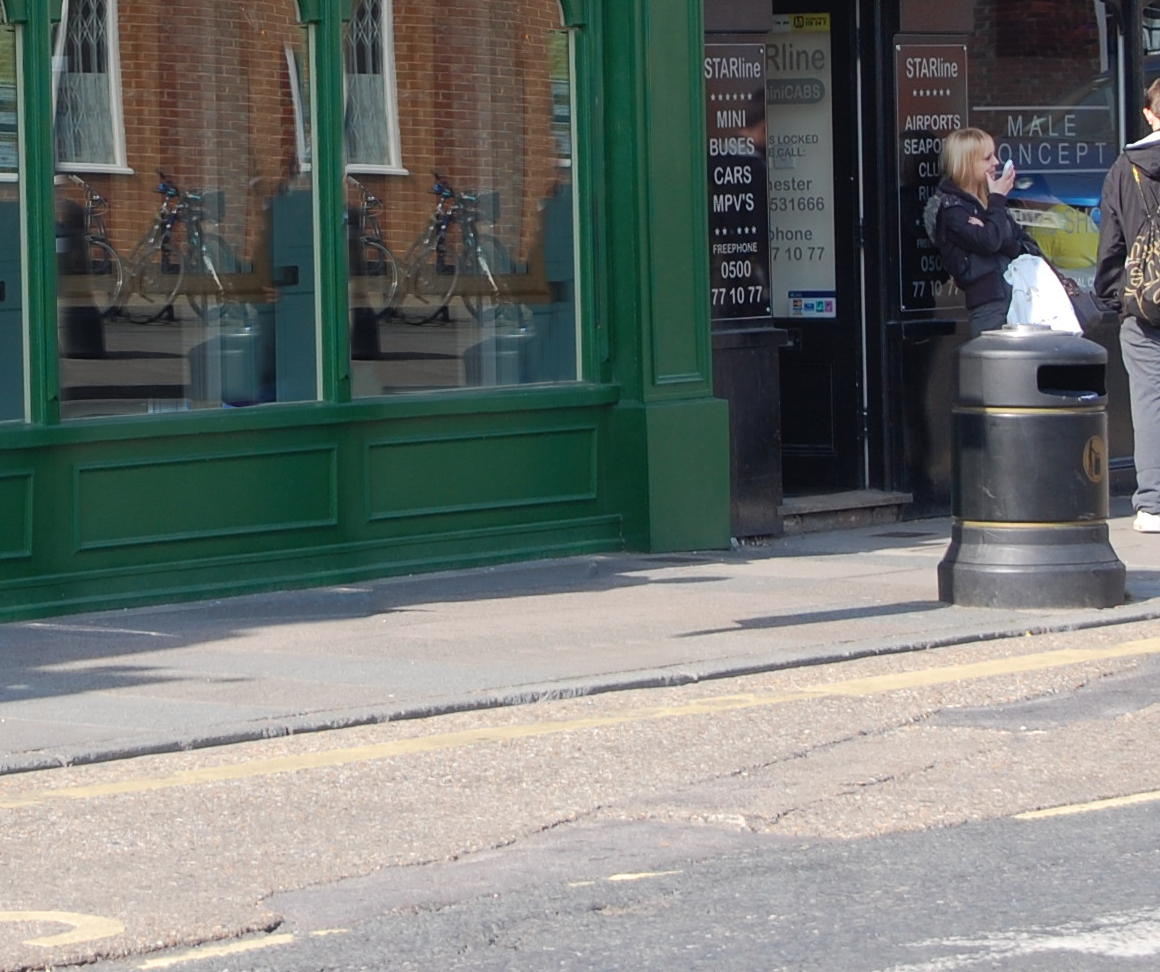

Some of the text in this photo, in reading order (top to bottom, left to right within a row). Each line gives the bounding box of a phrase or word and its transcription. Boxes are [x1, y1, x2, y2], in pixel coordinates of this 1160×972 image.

[765, 43, 826, 72] Rline
[704, 57, 761, 79] STARline
[906, 57, 959, 79] STARline
[716, 110, 746, 129] MINI
[904, 114, 961, 130] AIRPORTS
[1007, 114, 1076, 137] MALE
[709, 137, 755, 156] BUSES
[777, 134, 819, 145] LOCKED
[997, 142, 1107, 165] ONCEPT
[713, 166, 752, 185] CARS
[712, 193, 755, 213] MPV'S
[712, 241, 758, 255] FREEPHONE
[785, 246, 803, 261] 10
[806, 245, 826, 261] 77
[721, 260, 752, 279] 0500
[711, 285, 763, 306] 77 10 77
[912, 280, 926, 298] 77
[930, 280, 942, 298] 10
